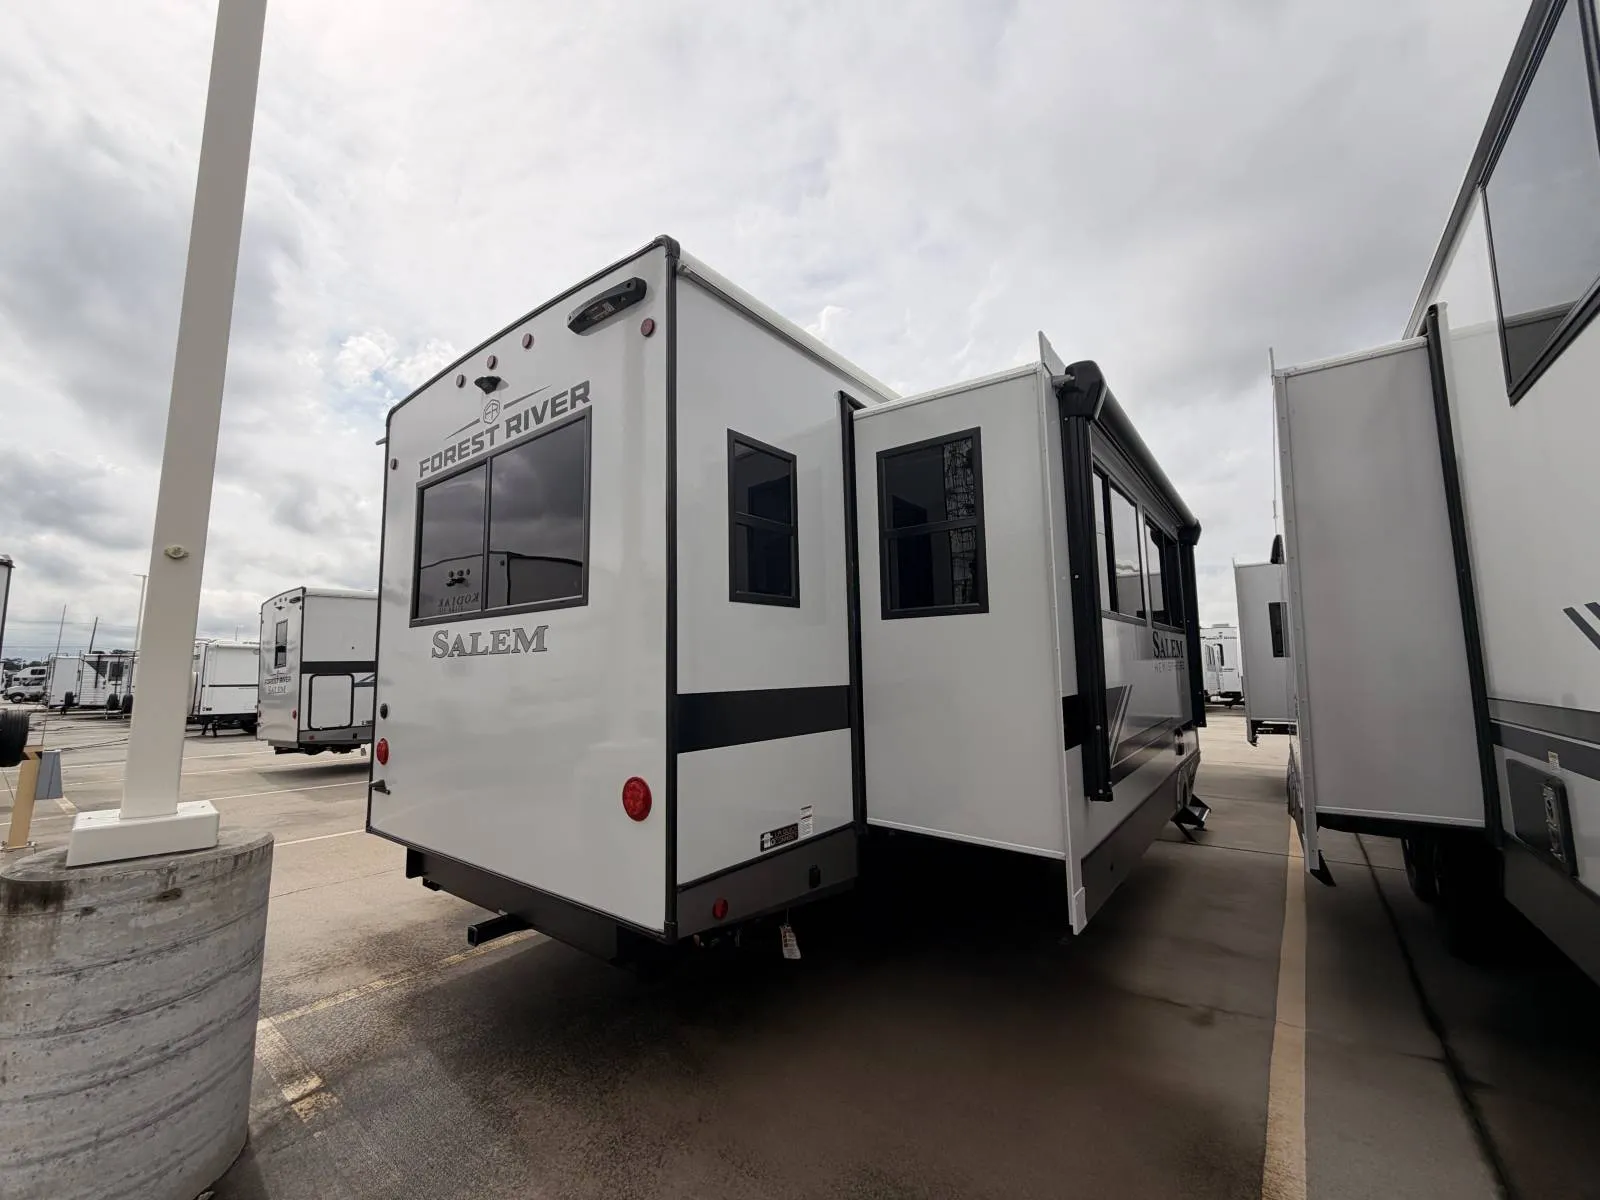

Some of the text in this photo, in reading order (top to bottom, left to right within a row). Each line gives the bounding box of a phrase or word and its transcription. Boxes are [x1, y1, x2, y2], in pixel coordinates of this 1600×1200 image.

[419, 380, 592, 478] FOREST RIVER
[432, 625, 549, 659] SALEM
[1153, 631, 1183, 658] SALEM
